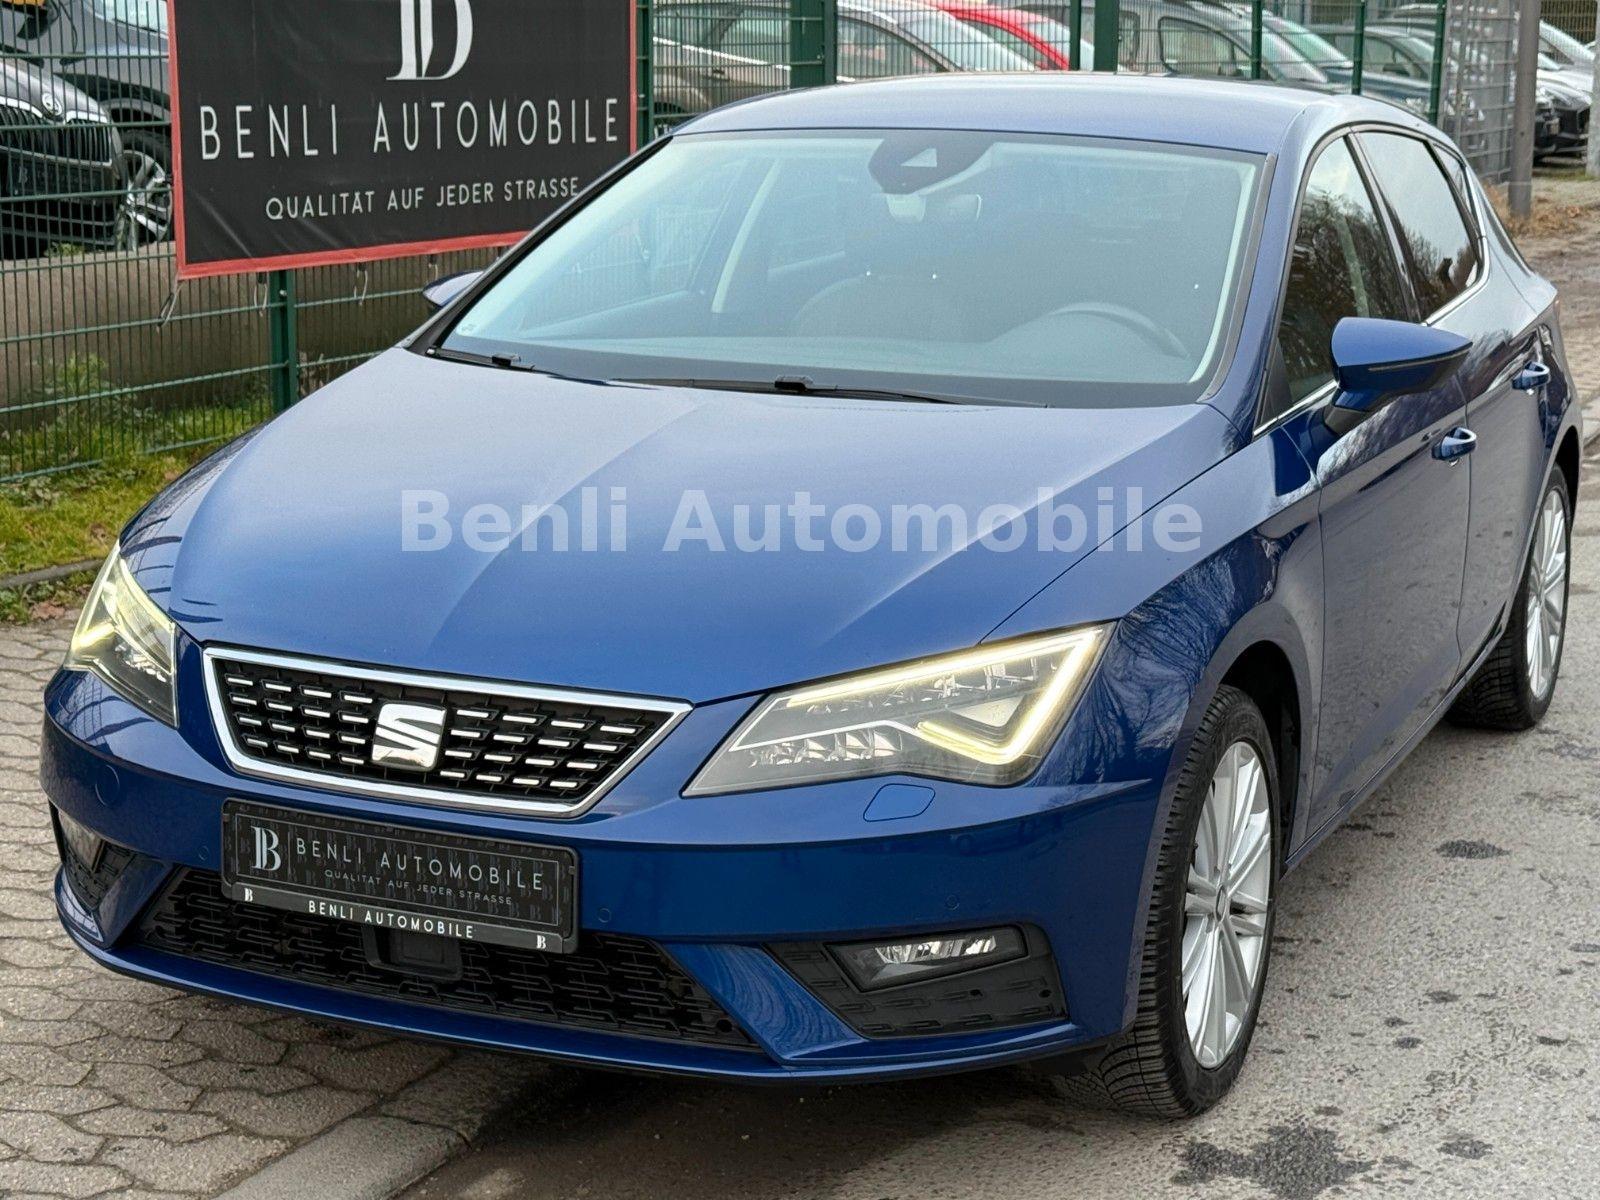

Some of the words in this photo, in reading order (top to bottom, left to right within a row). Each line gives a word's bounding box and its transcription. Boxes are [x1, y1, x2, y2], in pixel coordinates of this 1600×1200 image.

[200, 103, 338, 161] BENLI
[373, 98, 619, 153] AUTOMOBILE
[387, 187, 425, 211] AUF
[436, 182, 494, 207] JEDER
[503, 176, 579, 202] STRASSE
[296, 838, 362, 865] BENLI
[380, 853, 544, 891] AUTOMOBILE
[387, 879, 410, 889] AUF
[417, 884, 453, 896] JEDER
[459, 889, 513, 905] STRASSE
[308, 900, 354, 920] BENLI
[364, 910, 474, 939] AUTOMOBILE
